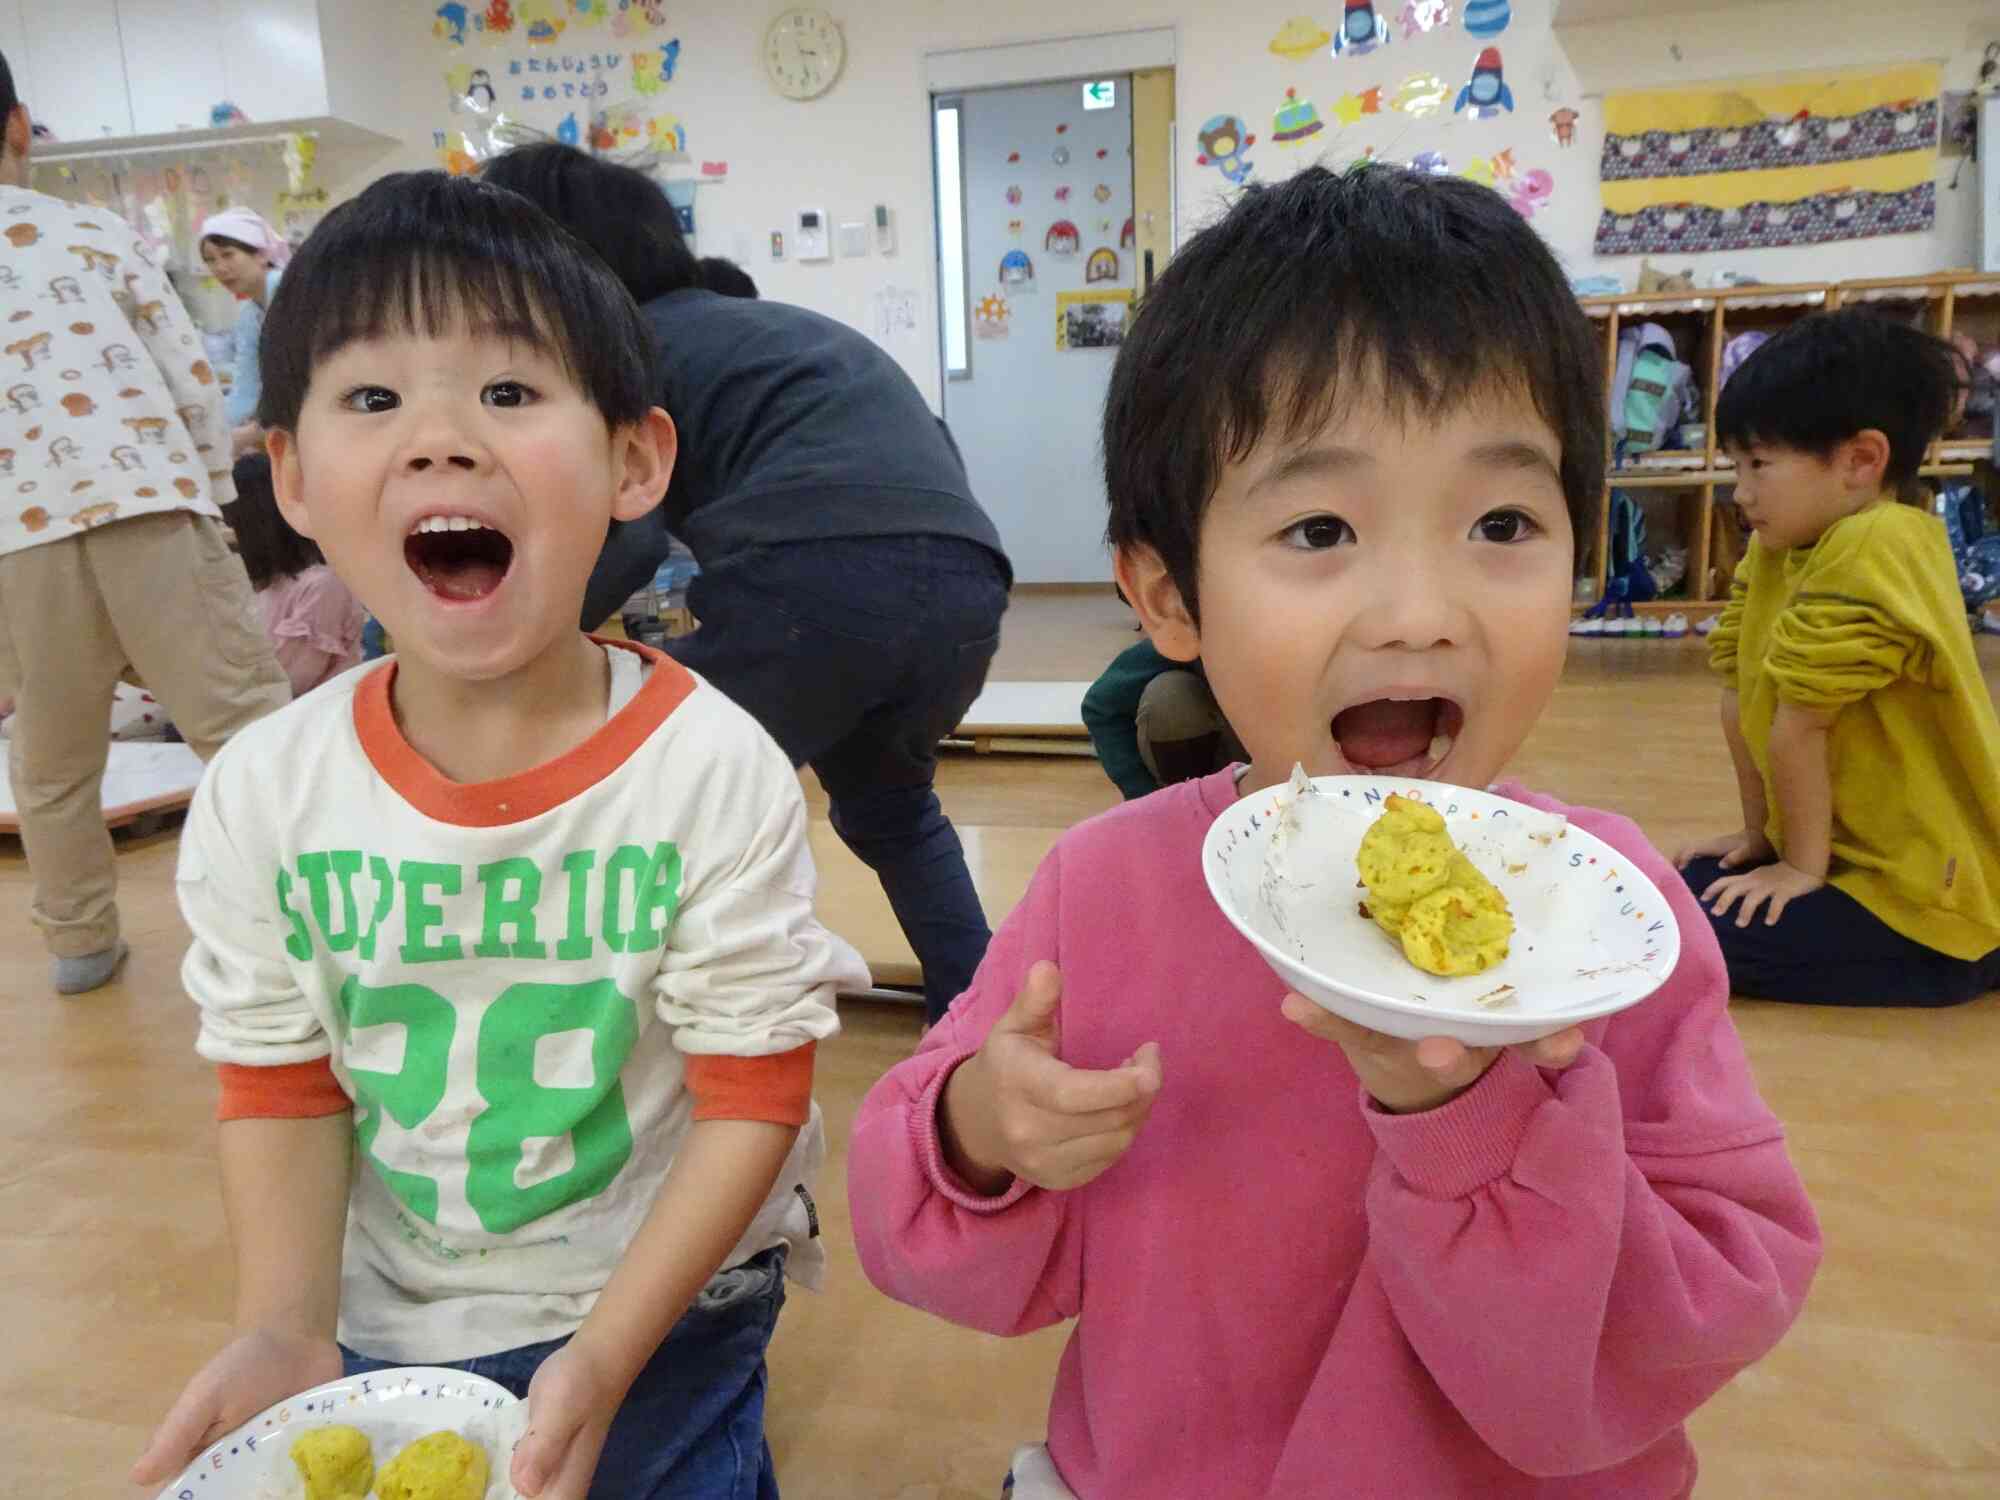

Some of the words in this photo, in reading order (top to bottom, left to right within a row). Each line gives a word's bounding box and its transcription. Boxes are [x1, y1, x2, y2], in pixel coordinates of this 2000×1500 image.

[509, 53, 619, 75] おたんじょうび
[521, 79, 608, 100] おめでとう
[1364, 787, 1381, 805] N
[1569, 853, 1583, 867] S
[277, 841, 684, 964] SUPERIOR
[212, 1453, 224, 1470] E
[246, 1436, 257, 1452] F
[321, 1400, 335, 1414] H
